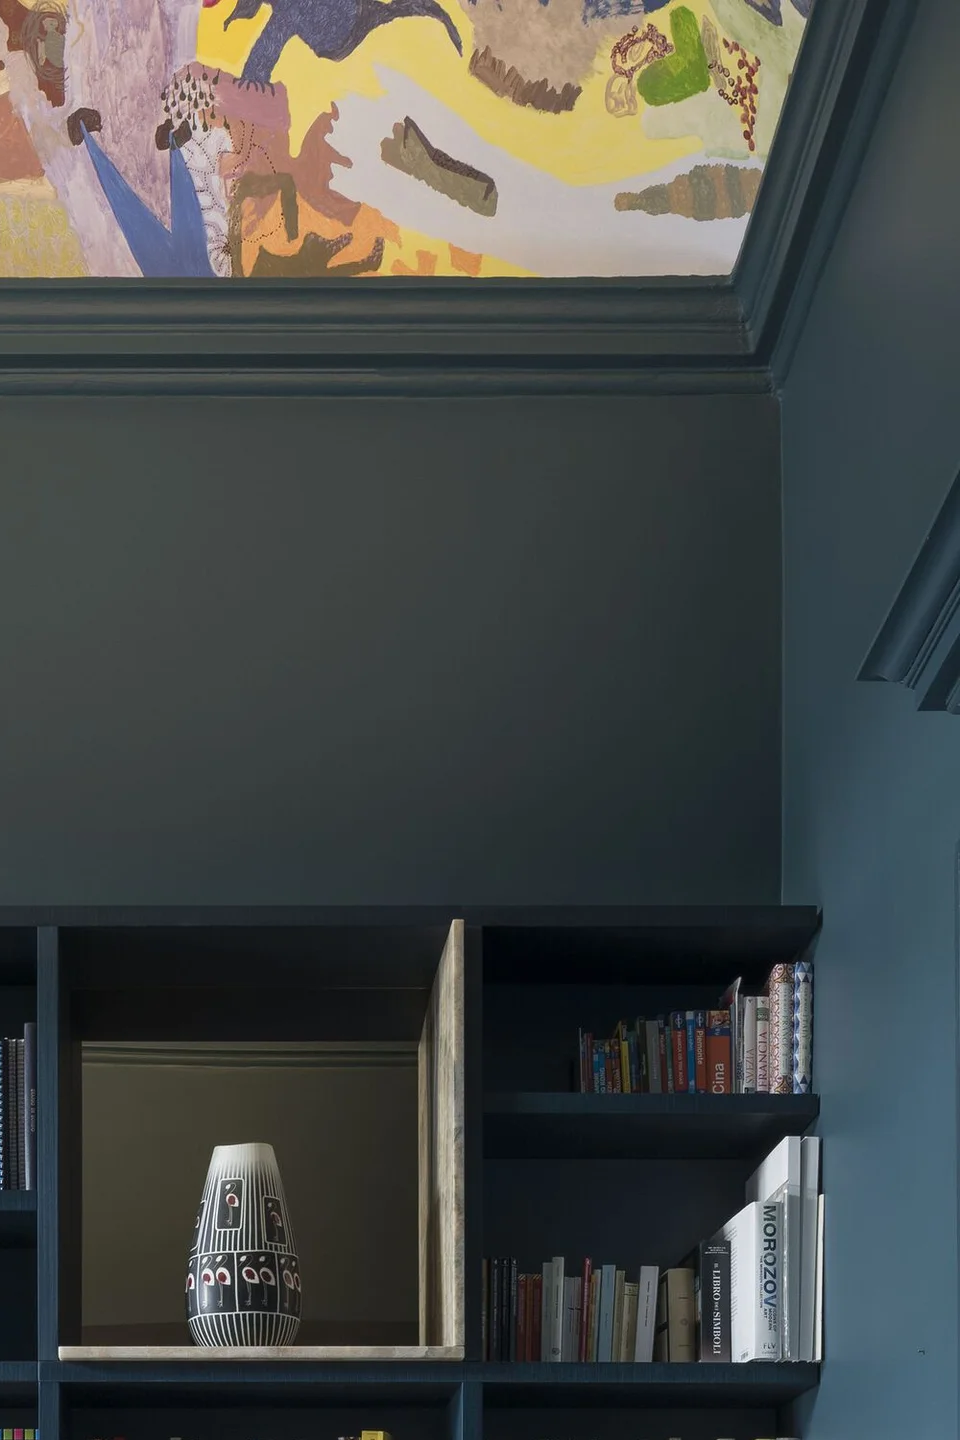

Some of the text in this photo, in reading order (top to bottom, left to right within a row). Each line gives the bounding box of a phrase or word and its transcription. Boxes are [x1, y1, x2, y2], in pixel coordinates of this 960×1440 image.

[696, 1030, 704, 1065] Piemonte
[758, 1031, 768, 1087] FRANCIA
[712, 1063, 725, 1094] Cina
[745, 1048, 754, 1084] SVEZIA
[763, 1205, 777, 1309] MOROZOV
[712, 1270, 721, 1301] LIBRO
[712, 1311, 721, 1354] SIMBOLI
